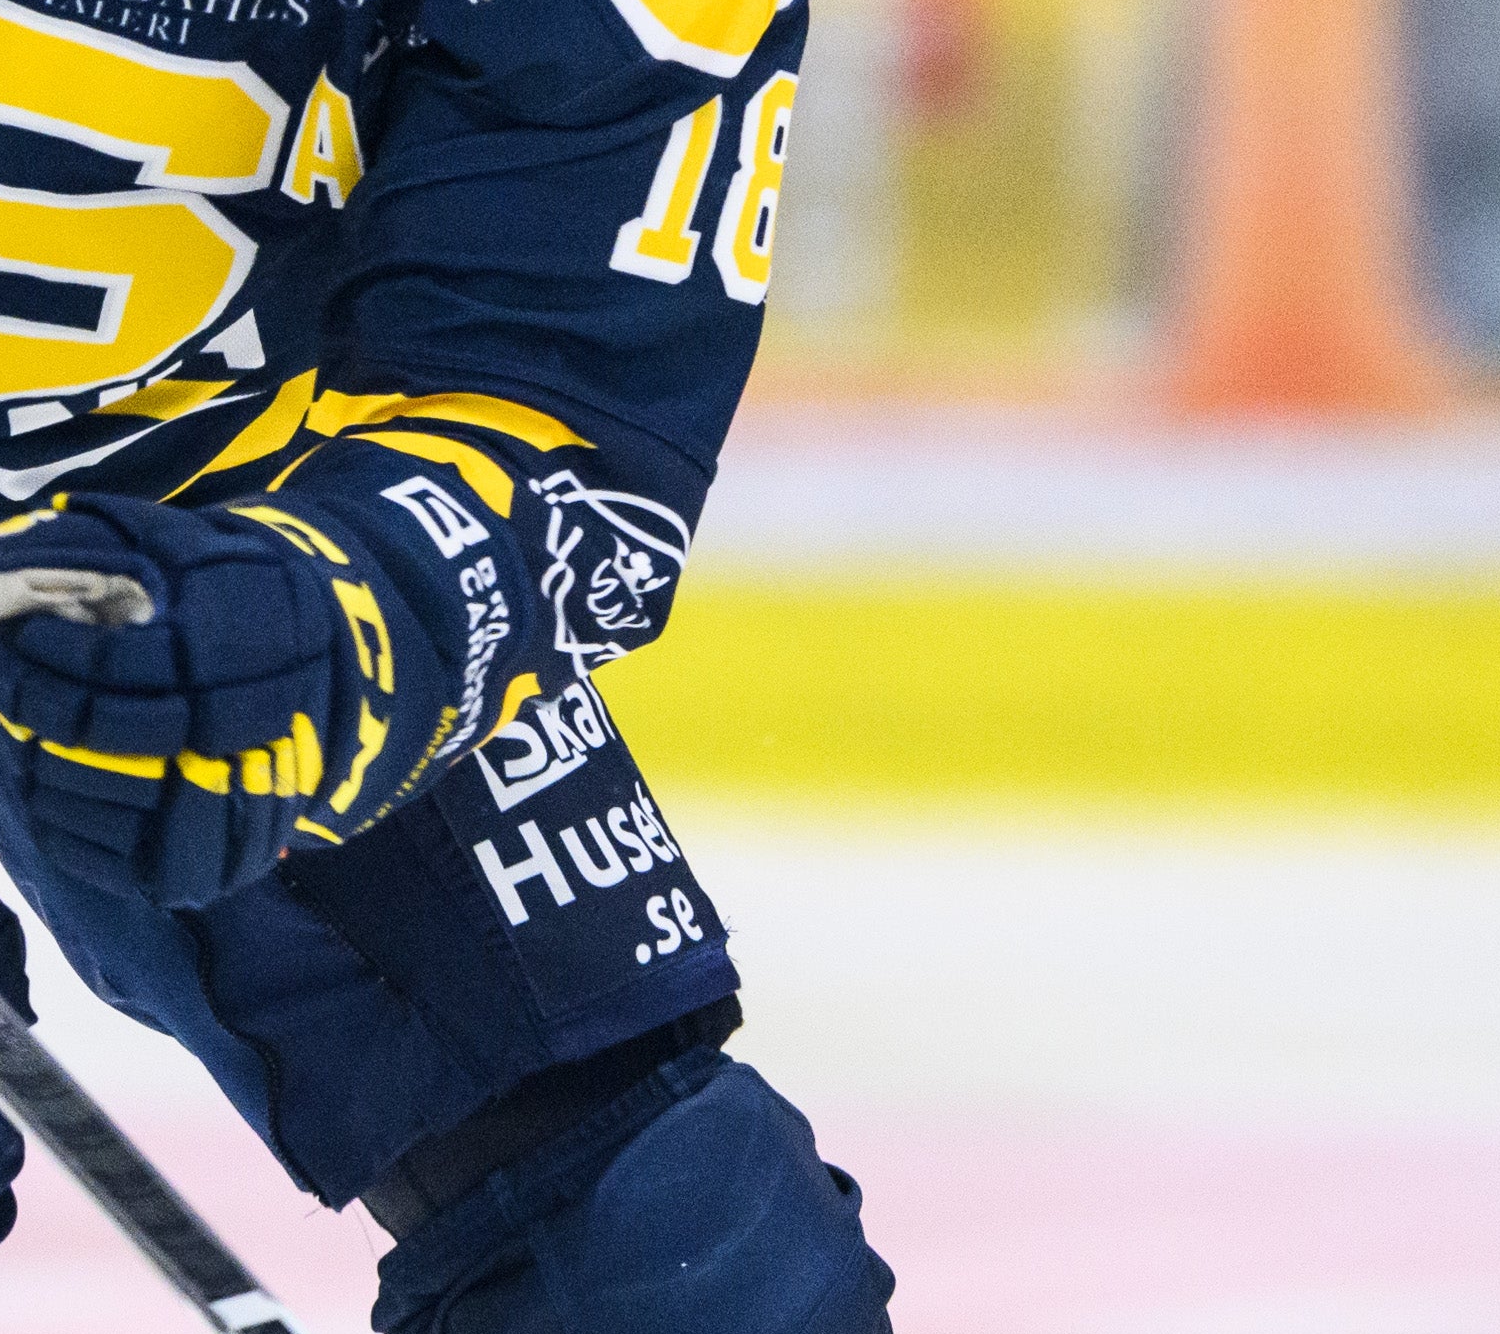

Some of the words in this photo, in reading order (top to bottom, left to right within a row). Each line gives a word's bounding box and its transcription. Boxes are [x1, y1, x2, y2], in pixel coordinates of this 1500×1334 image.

[281, 63, 365, 210] A
[609, 69, 800, 306] 18
[634, 886, 704, 966] .se
